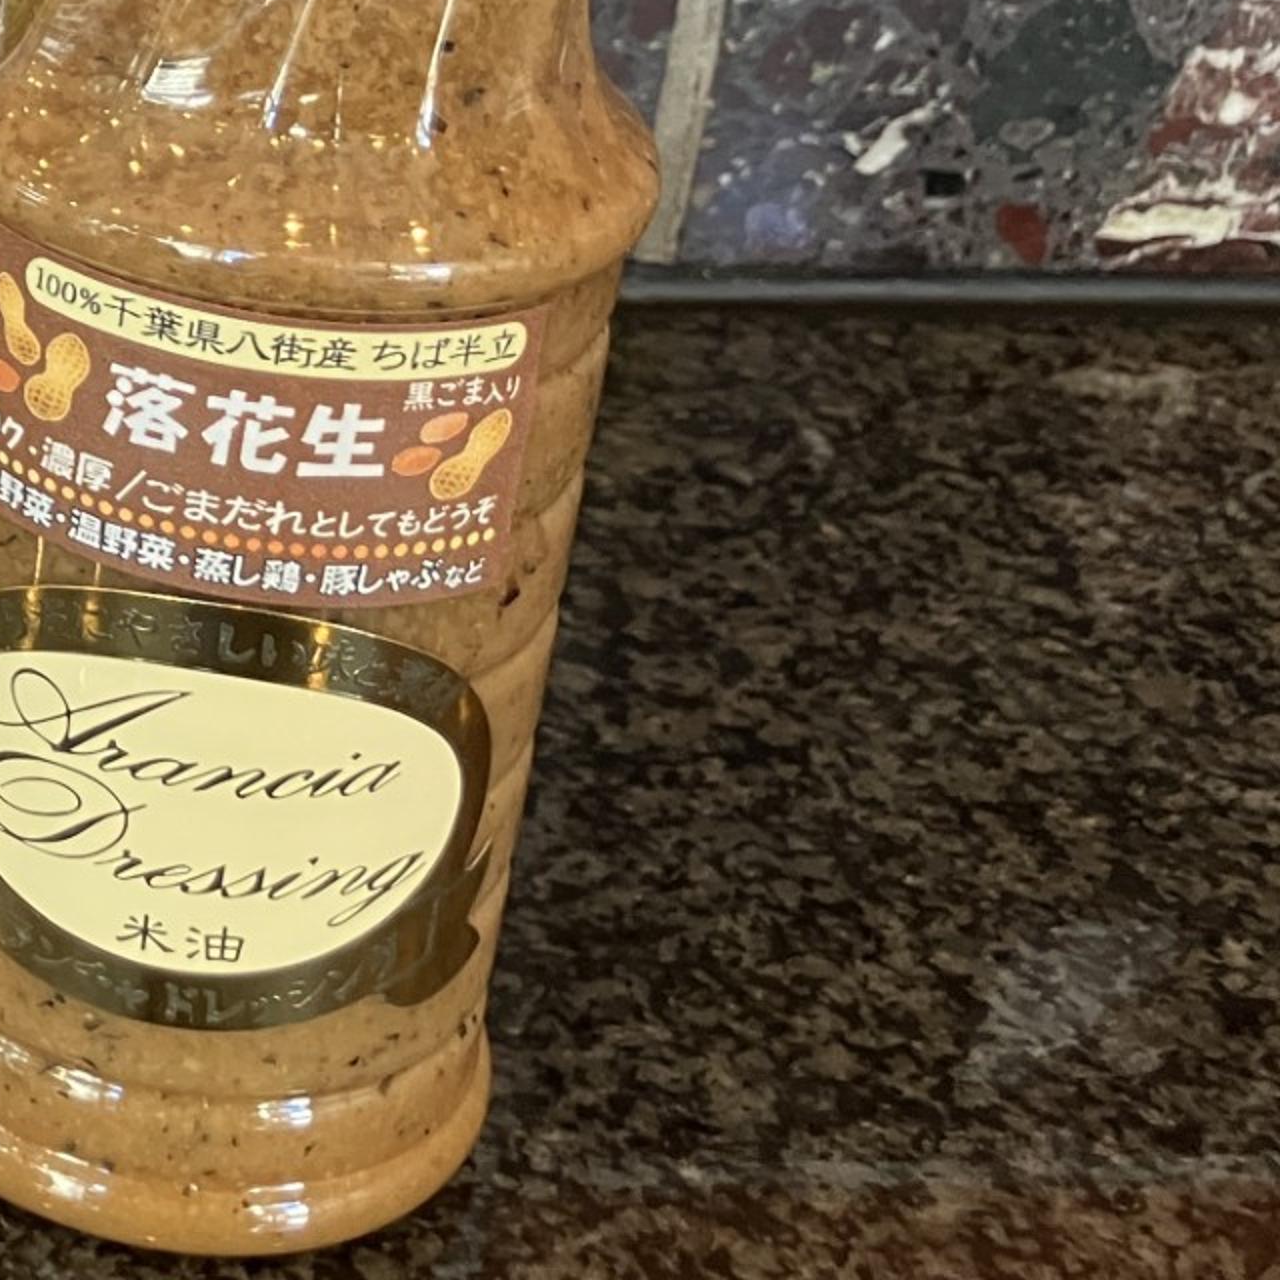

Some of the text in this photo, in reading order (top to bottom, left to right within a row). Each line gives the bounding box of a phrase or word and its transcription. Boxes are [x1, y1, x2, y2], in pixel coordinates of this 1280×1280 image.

[35, 265, 518, 371] 100%千葉県八街産 ちば半立
[101, 361, 385, 478] 落花生
[401, 375, 521, 412] 黒ごま入り
[115, 914, 245, 963] 米油
